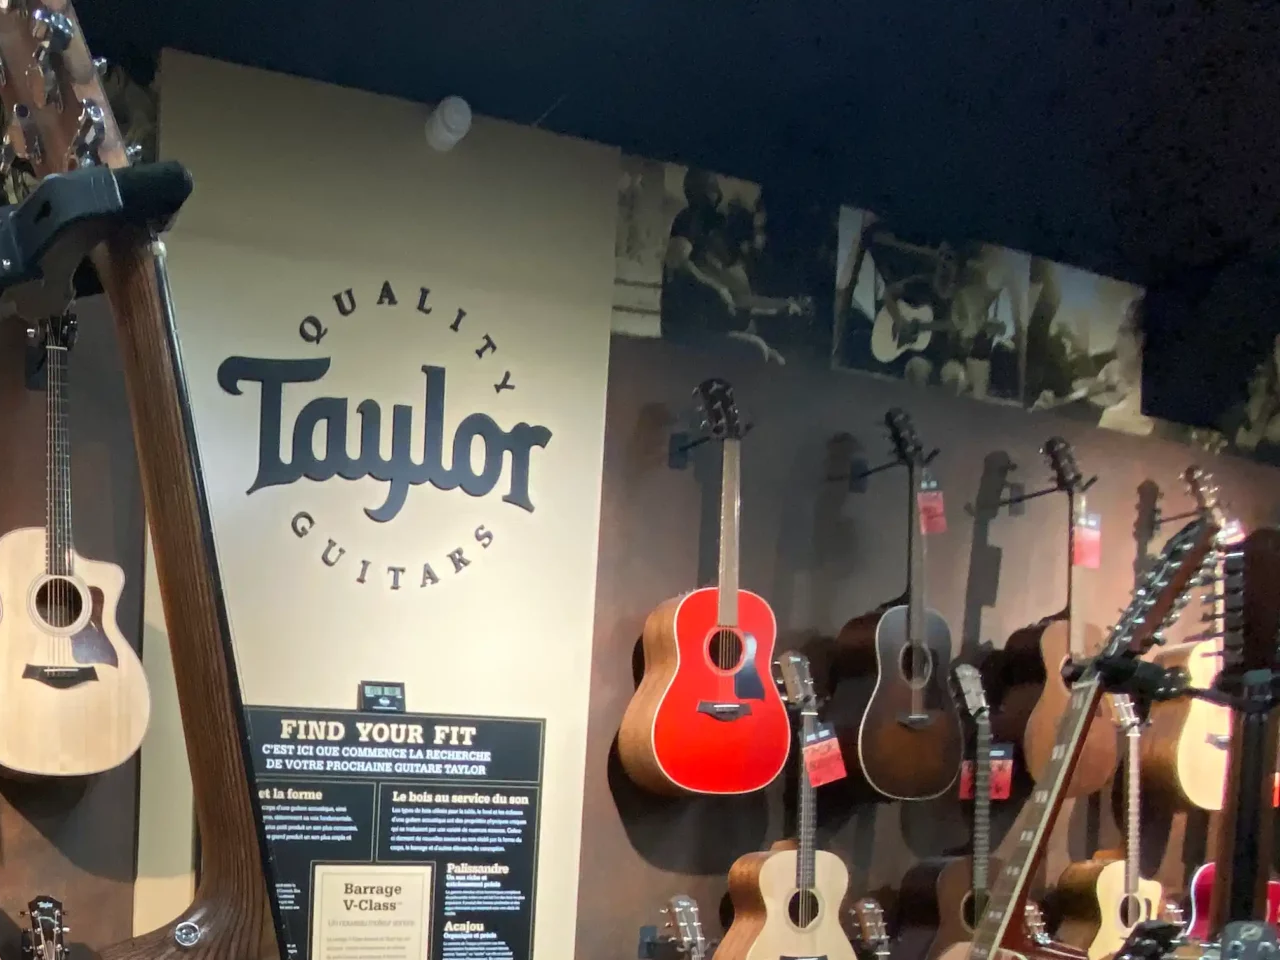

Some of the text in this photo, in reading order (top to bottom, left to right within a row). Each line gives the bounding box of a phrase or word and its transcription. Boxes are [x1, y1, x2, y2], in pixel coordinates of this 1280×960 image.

[298, 280, 516, 394] QUALITY
[217, 355, 553, 523] Taylor
[290, 510, 494, 591] GUITARS
[280, 719, 477, 746] FIND YOUR FIT
[262, 743, 492, 762] C'EST ICI QUE COMMENCE LA RECHERCHE
[265, 758, 487, 775] DE VOTRE PROCHAINE GUITARE TAYLOR
[273, 788, 285, 799] la
[287, 788, 323, 800] forme
[392, 791, 529, 805] Le bois au service du son
[446, 863, 510, 875] Palissandre
[343, 883, 402, 897] Barrage
[444, 921, 484, 933] Acajou
